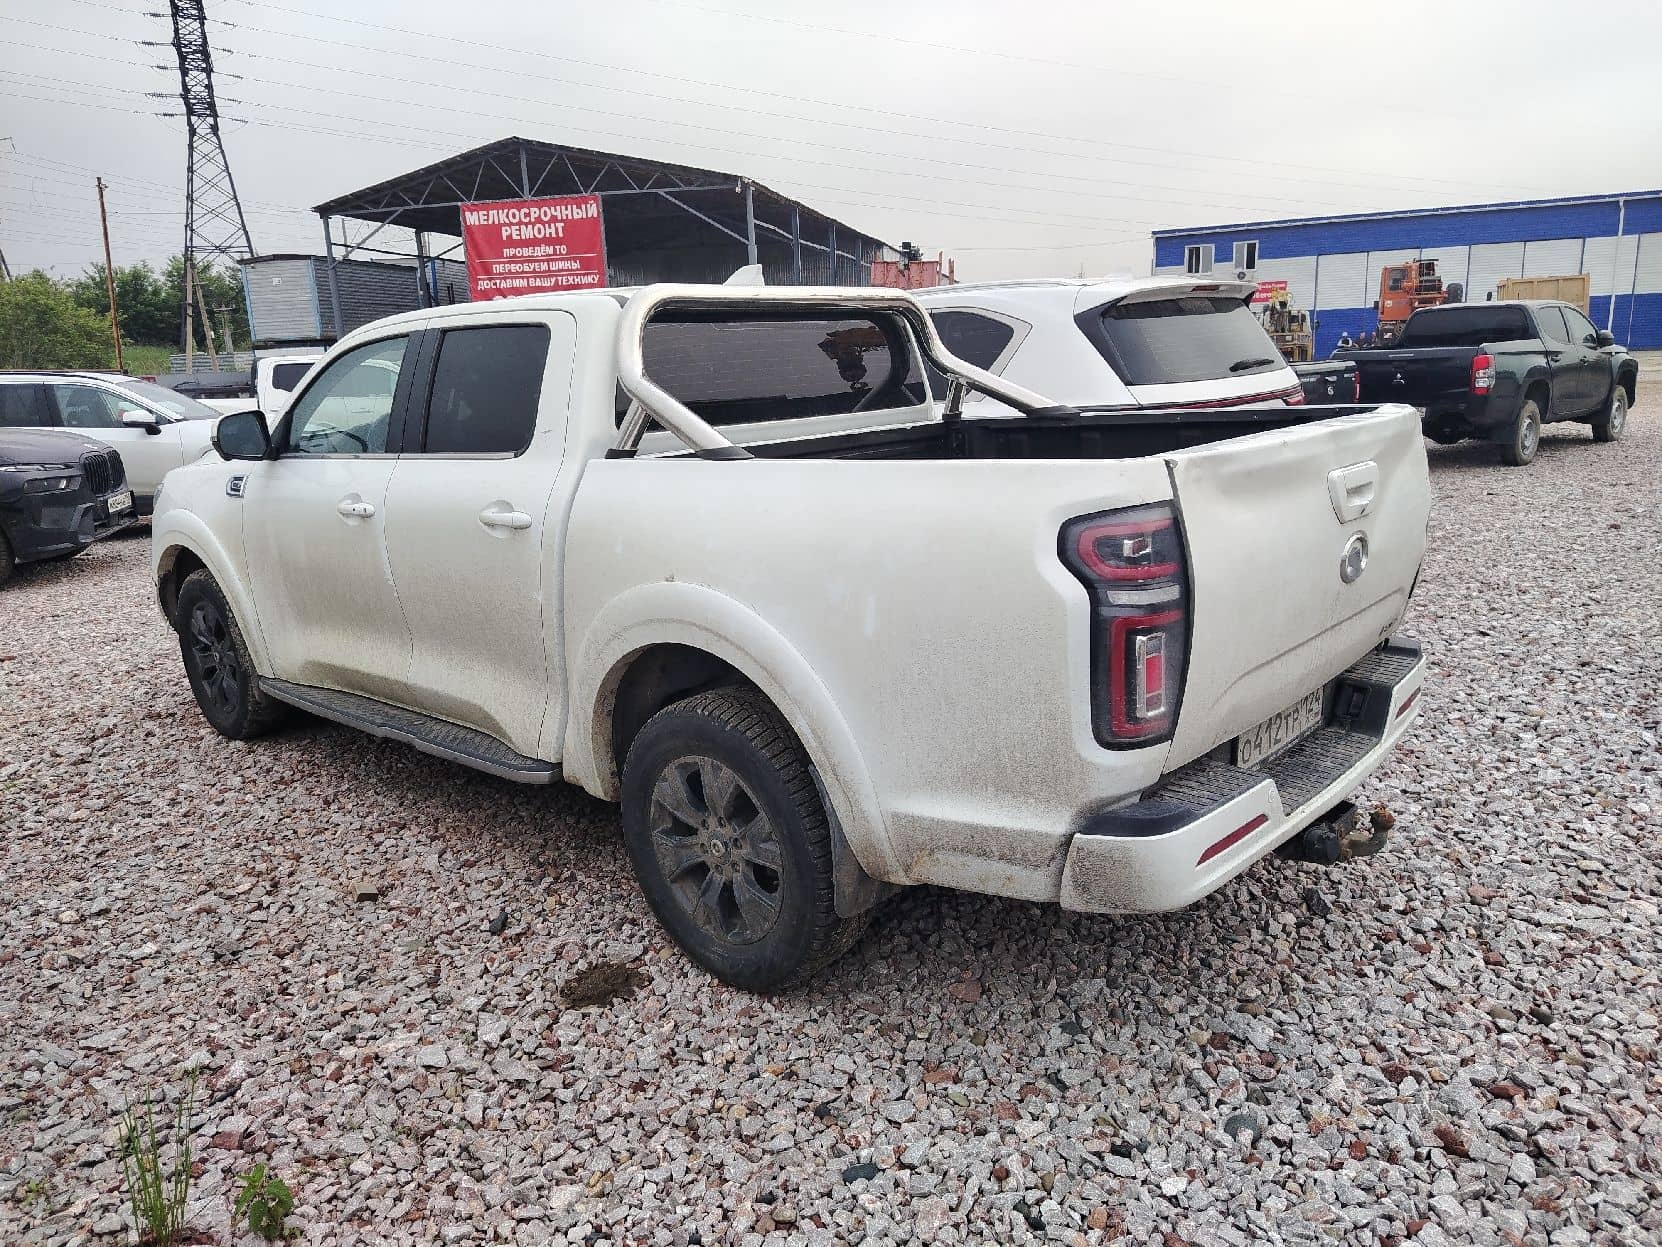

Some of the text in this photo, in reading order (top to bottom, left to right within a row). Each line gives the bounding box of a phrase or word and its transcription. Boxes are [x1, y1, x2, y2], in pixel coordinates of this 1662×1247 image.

[464, 200, 598, 226] МЕЛКОСРОЧНЫЙ
[501, 222, 565, 241] РЕМОНТ
[503, 244, 567, 258] ПРОВЕДЁМ ТО
[492, 259, 581, 274] ПЕРЕОБУЕМ ШИНЫ
[477, 274, 600, 291] ДОСТАВИМ ВАШУ ТЕХНИКУ
